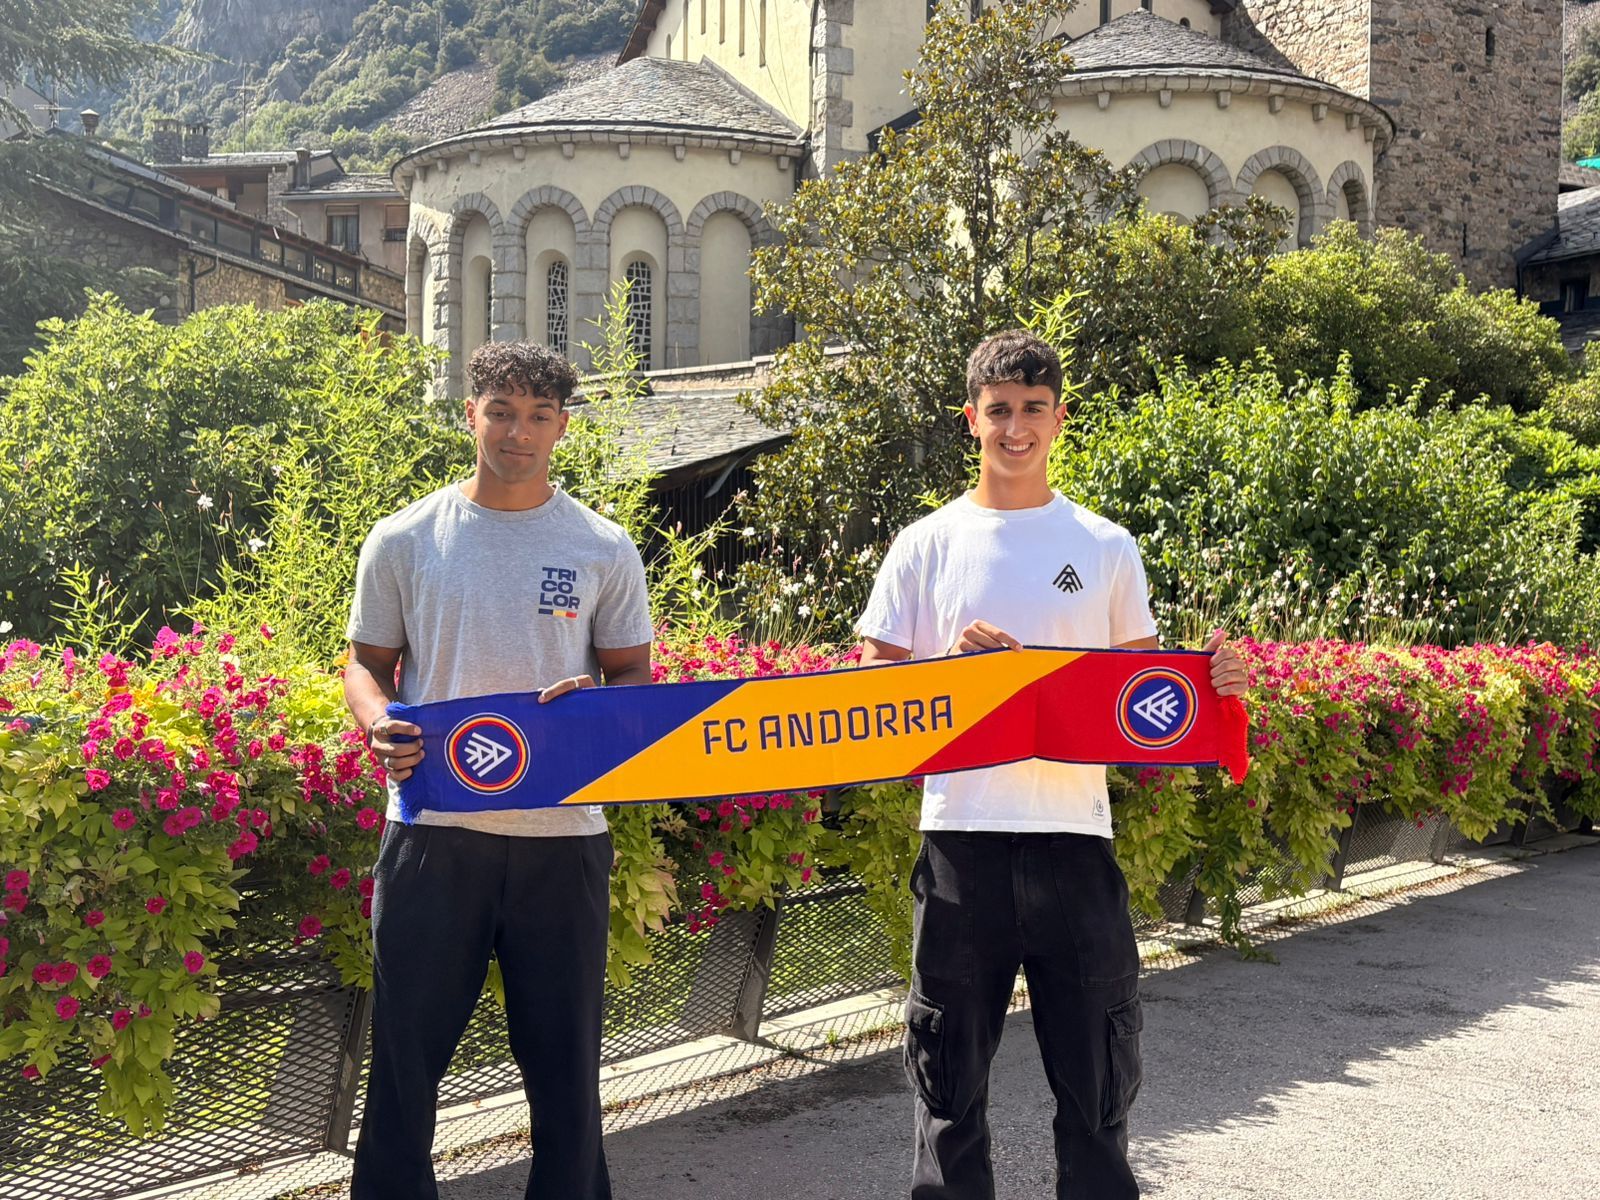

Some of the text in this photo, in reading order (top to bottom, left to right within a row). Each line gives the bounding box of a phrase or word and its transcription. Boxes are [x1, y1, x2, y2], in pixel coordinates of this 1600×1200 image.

[542, 566, 576, 582] TRI
[541, 579, 574, 594] CO
[539, 592, 580, 609] LOR
[703, 695, 953, 754] FC ANDORRA
